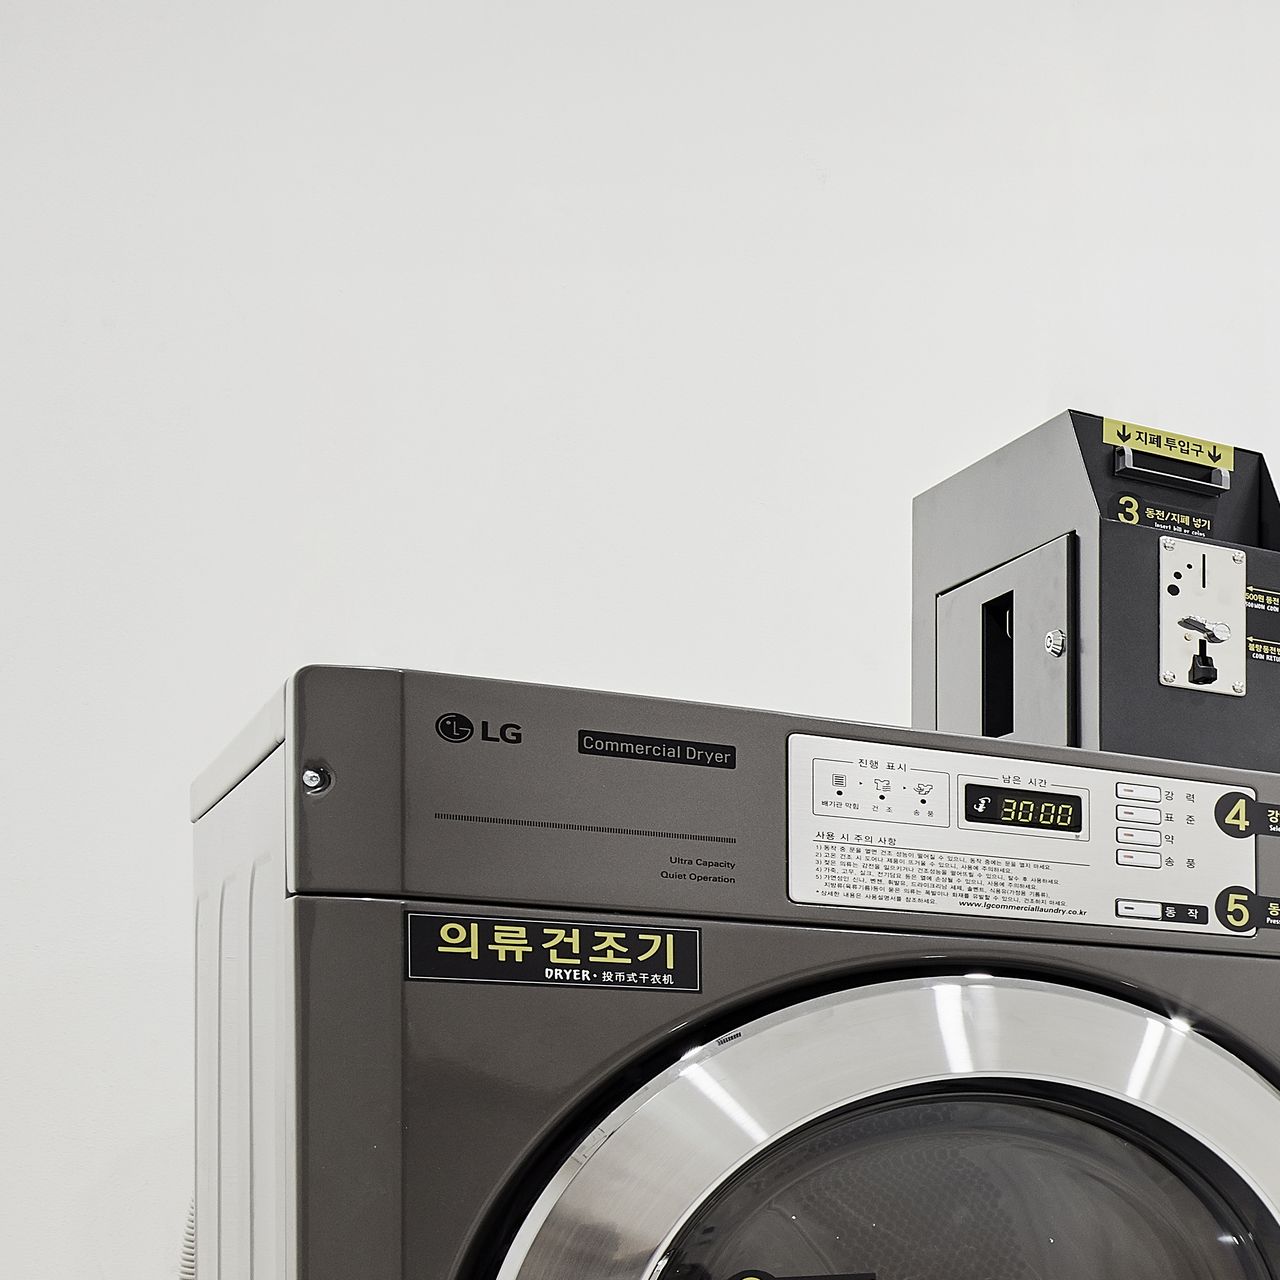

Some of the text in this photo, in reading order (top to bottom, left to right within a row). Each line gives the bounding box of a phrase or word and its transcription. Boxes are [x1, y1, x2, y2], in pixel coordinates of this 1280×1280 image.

[1135, 431, 1205, 457] 지폐 투입구
[1117, 496, 1140, 525] 3
[1145, 507, 1211, 531] 동전/지폐 넣기
[481, 720, 523, 745] LG
[583, 735, 732, 766] Commercial Dryer
[858, 758, 908, 773] 진행 표시
[1002, 775, 1048, 788] 남은 시간
[1224, 798, 1250, 831] 4
[815, 831, 897, 847] 사용 주의 사항
[1164, 833, 1175, 846] 약
[669, 856, 736, 870] Ultra Capacity
[660, 870, 736, 884] Quiet Operation
[959, 900, 1088, 917] www.lgcommerciallaundry.co.kr
[1226, 893, 1250, 927] 5
[544, 968, 674, 986] DRYER 投币式干衣机
